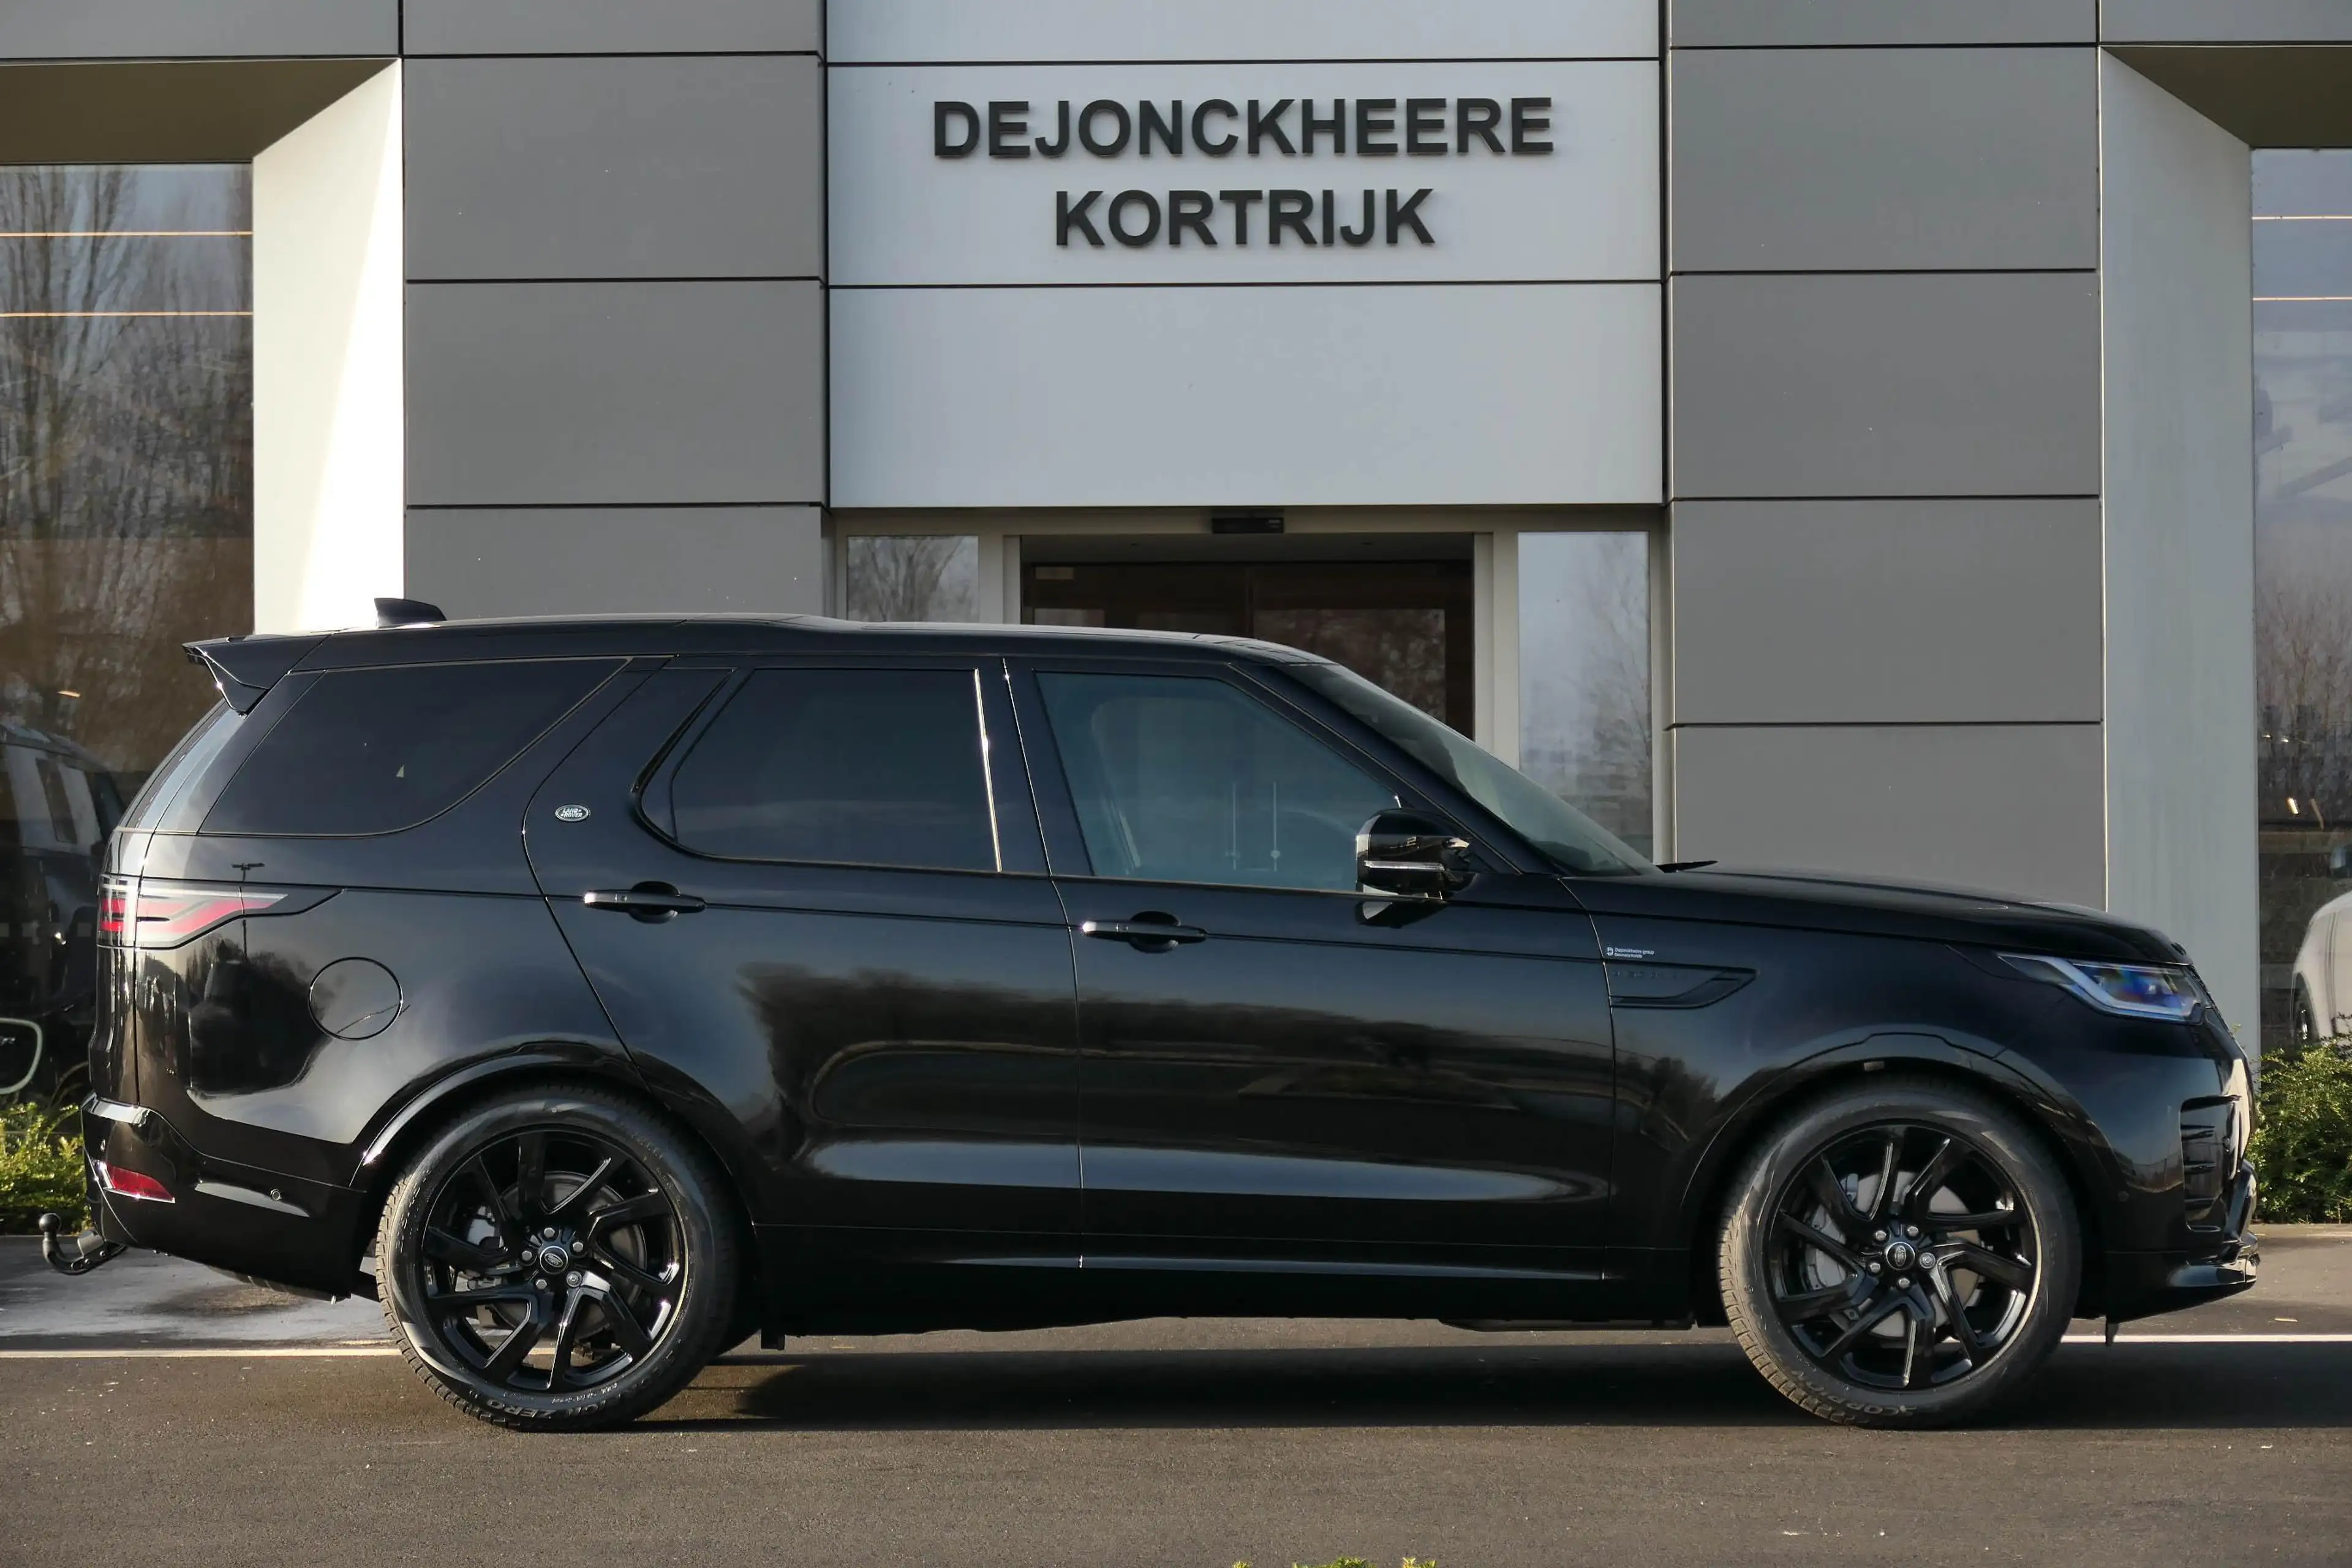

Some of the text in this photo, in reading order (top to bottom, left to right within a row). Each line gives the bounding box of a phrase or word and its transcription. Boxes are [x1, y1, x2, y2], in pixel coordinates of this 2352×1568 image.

[934, 96, 1553, 159] DEJONCKHEERE
[1055, 187, 1434, 249] KORTRIJK
[487, 1398, 556, 1419] ZERO
